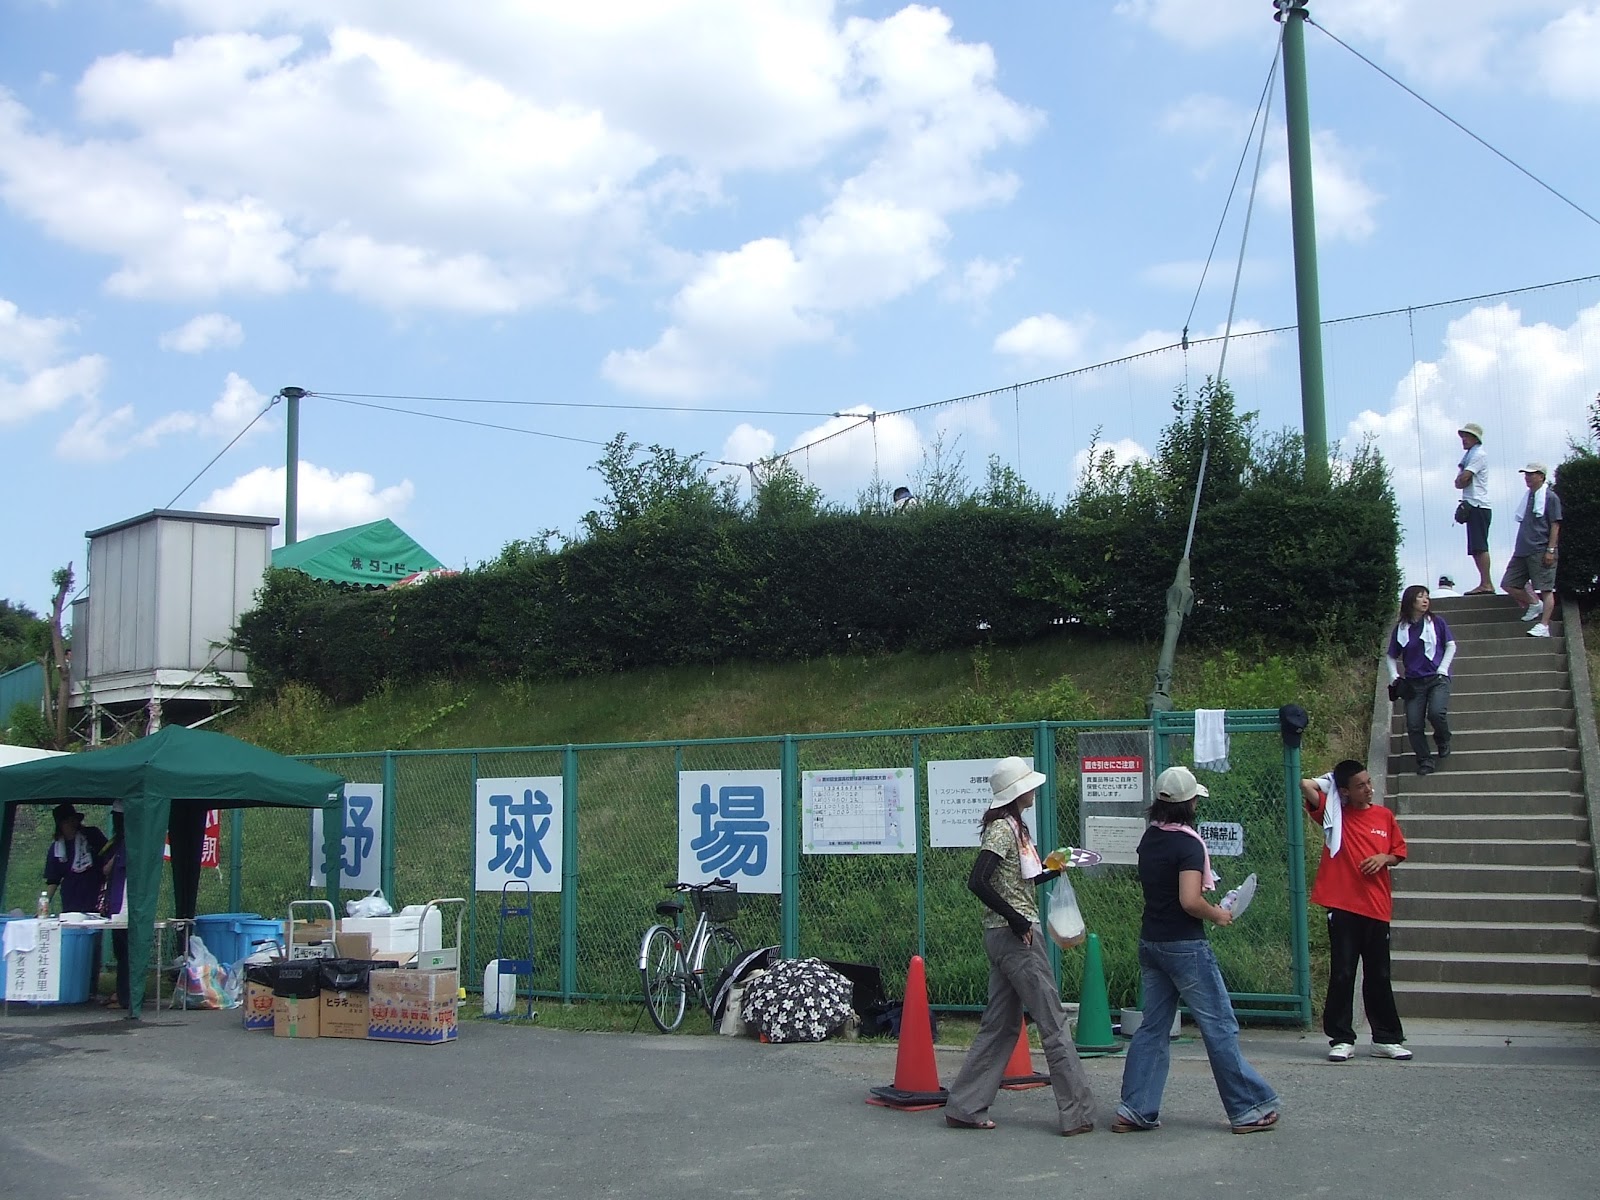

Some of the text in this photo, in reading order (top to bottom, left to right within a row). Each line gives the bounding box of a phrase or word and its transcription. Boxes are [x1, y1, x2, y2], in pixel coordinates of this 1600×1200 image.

[369, 559, 424, 576] タンビー
[488, 788, 553, 879] 球
[690, 783, 770, 879] 場
[1200, 826, 1238, 841] 駐輪禁止
[16, 951, 27, 991] 者受付
[37, 929, 51, 991] 同志社香里
[326, 998, 349, 1008] ヒラキ
